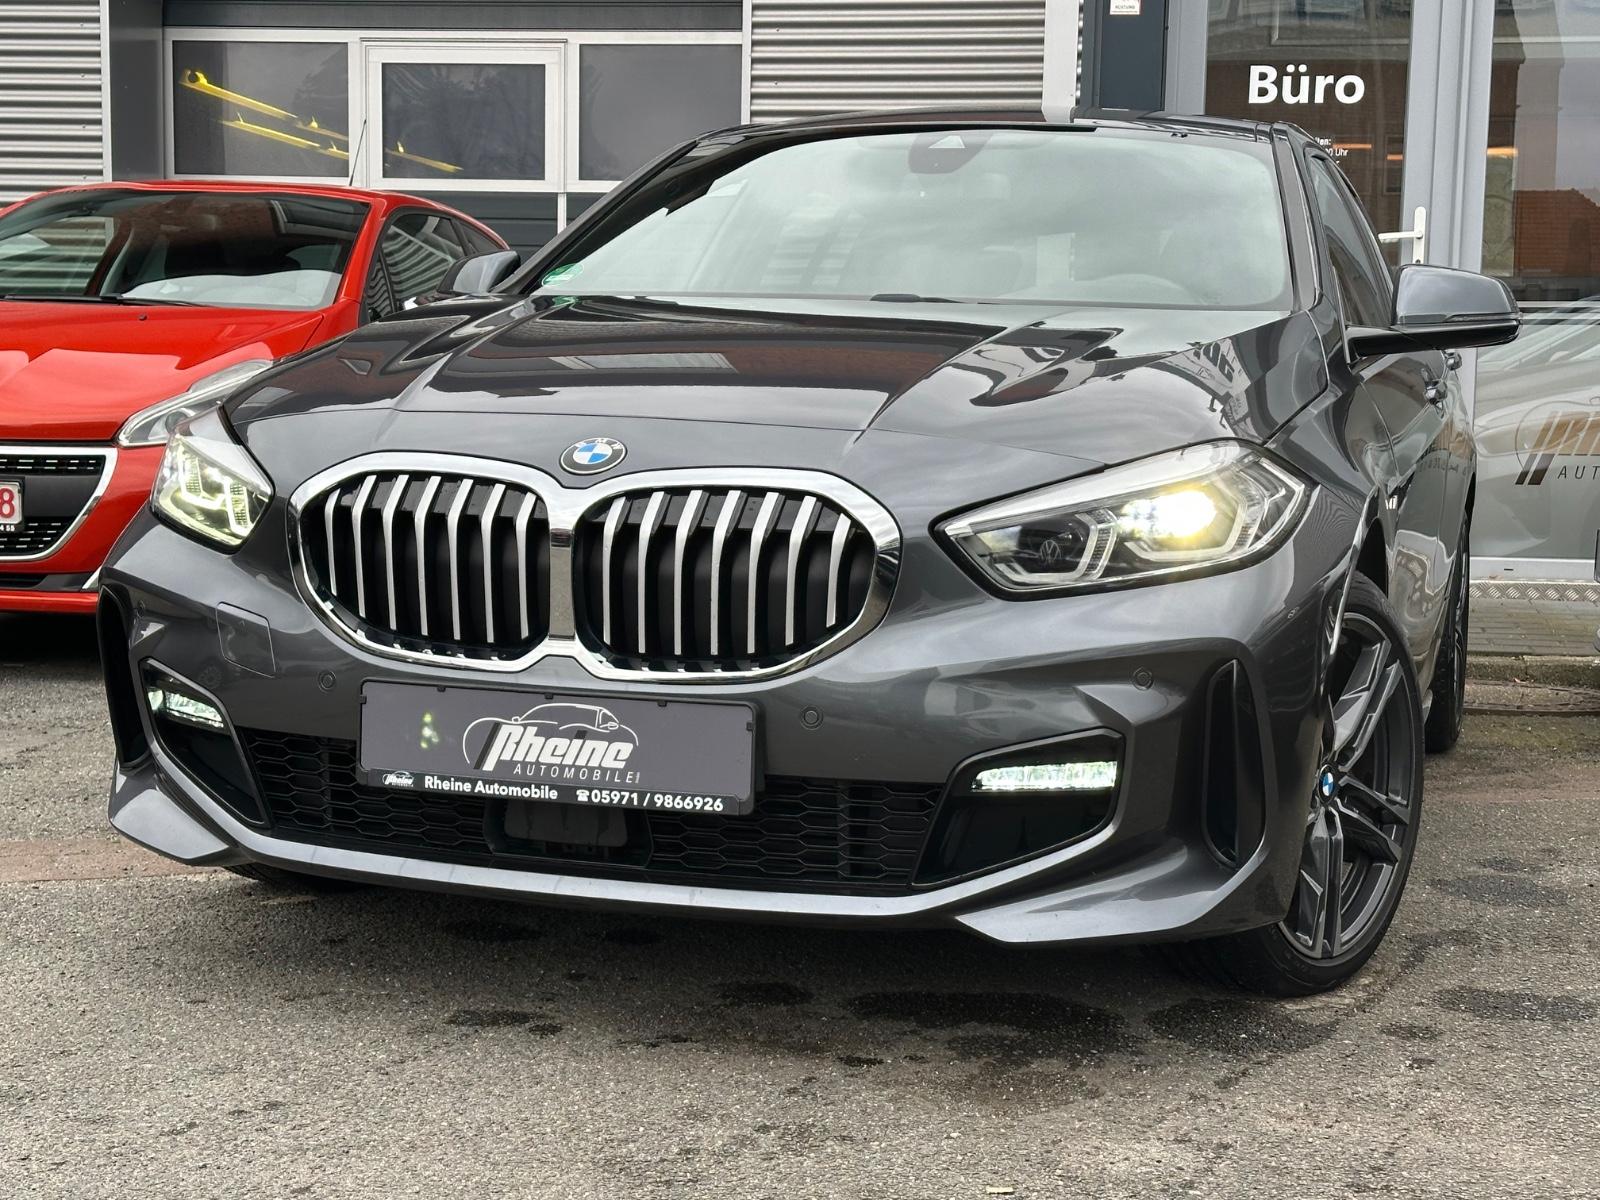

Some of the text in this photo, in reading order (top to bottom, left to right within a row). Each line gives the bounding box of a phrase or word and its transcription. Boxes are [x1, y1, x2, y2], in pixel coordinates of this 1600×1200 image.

[1248, 64, 1365, 104] Büro
[1335, 148, 1349, 157] Uhr
[0, 488, 15, 518] 8
[481, 724, 634, 771] Rheine
[513, 763, 634, 783] AUTOMOBILE
[424, 775, 724, 812] Rheine Automobile 05971 / 9866926
